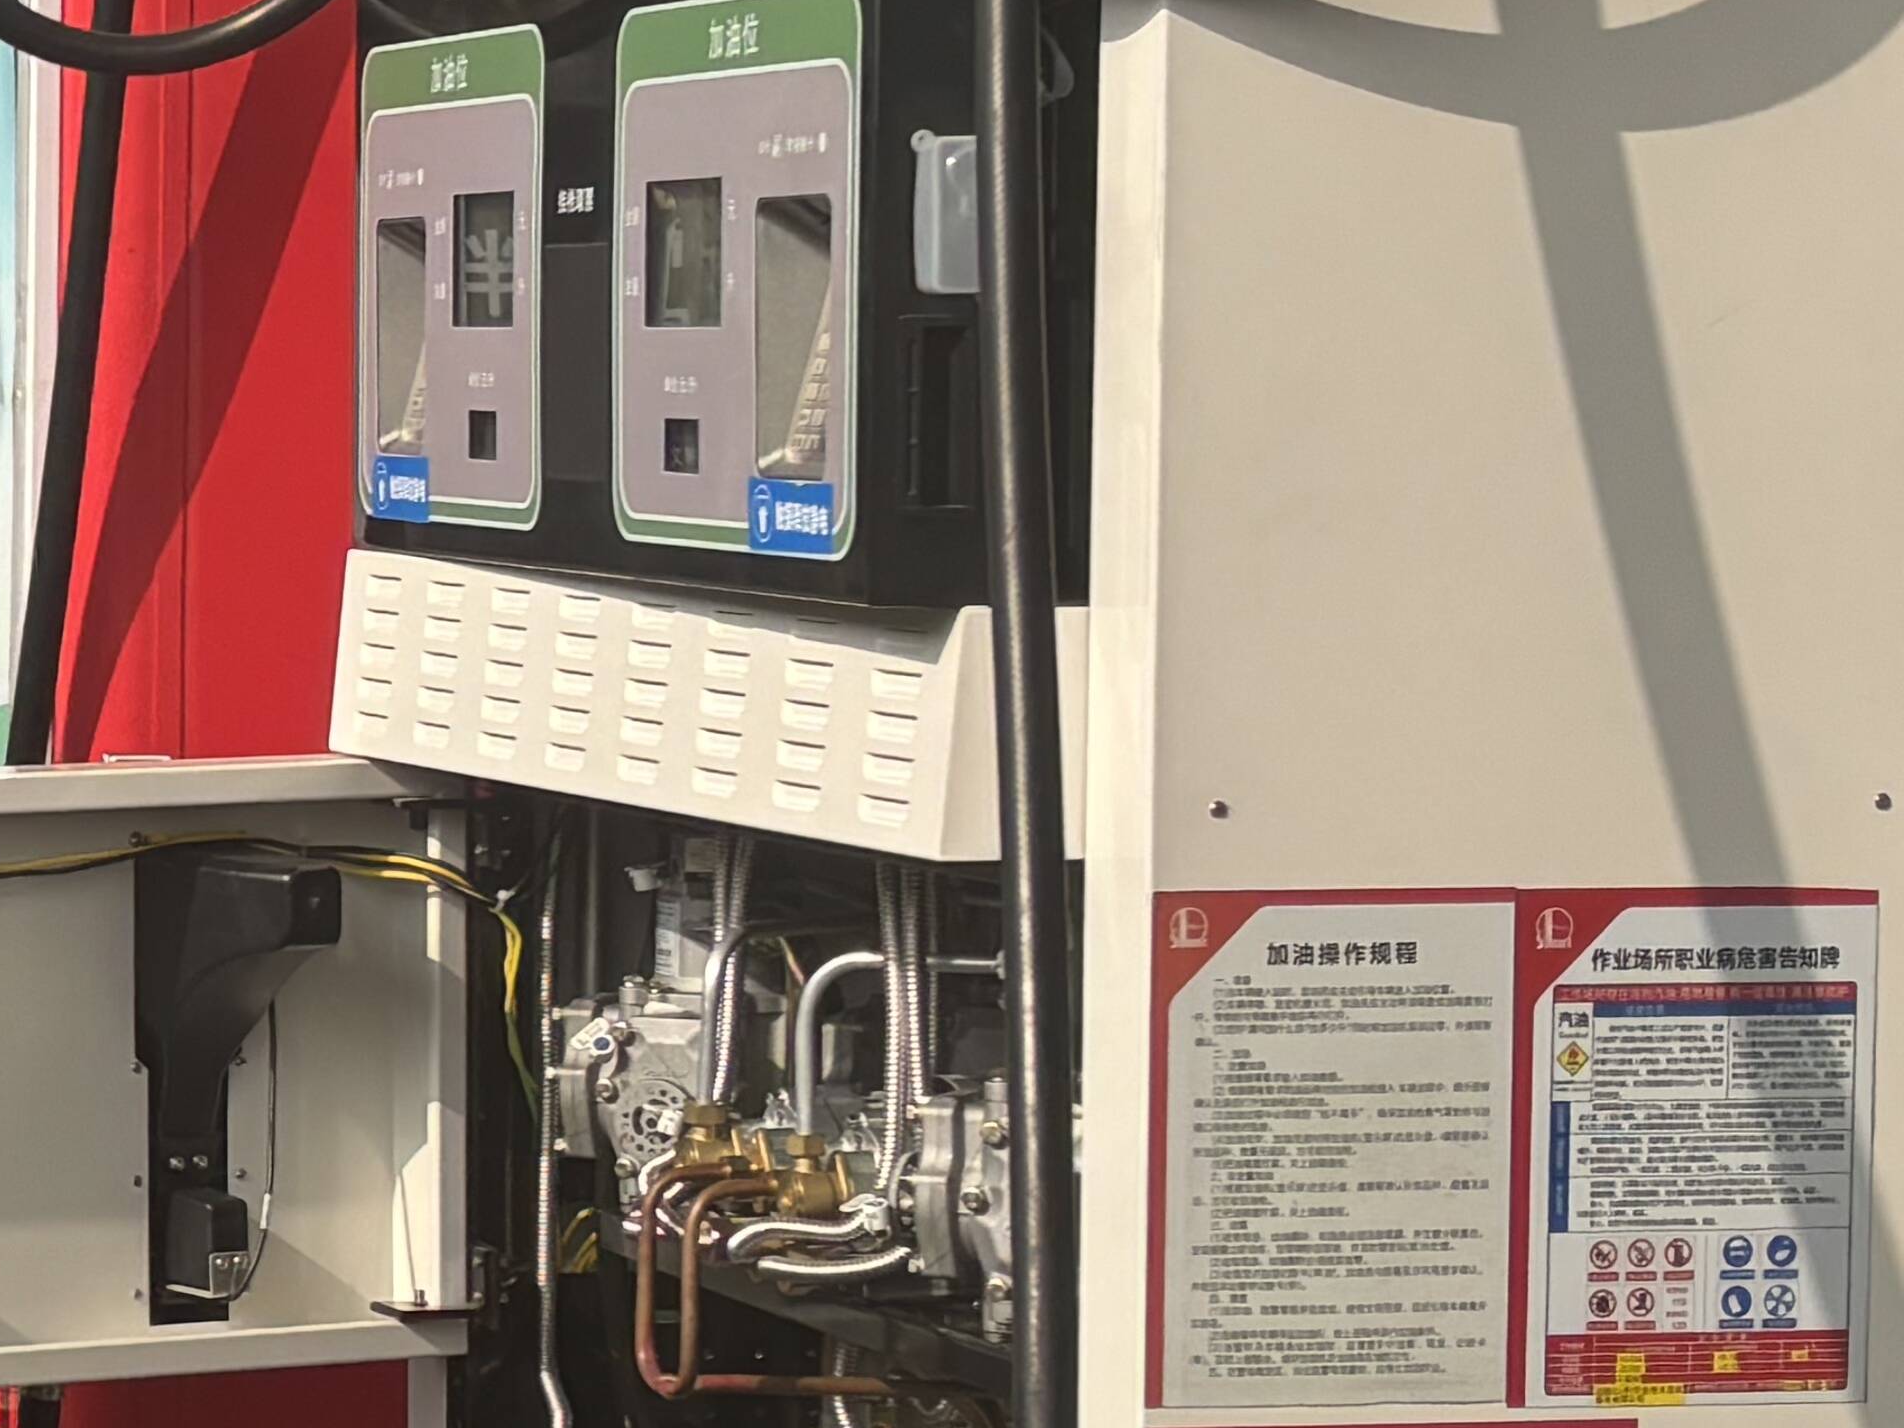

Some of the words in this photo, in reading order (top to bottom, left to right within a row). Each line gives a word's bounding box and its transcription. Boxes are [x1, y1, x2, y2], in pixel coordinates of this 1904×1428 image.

[709, 13, 759, 59] 加油位
[1266, 941, 1418, 966] 加油操作规程
[1592, 947, 1841, 971] 作业场所职业病危害告知牌
